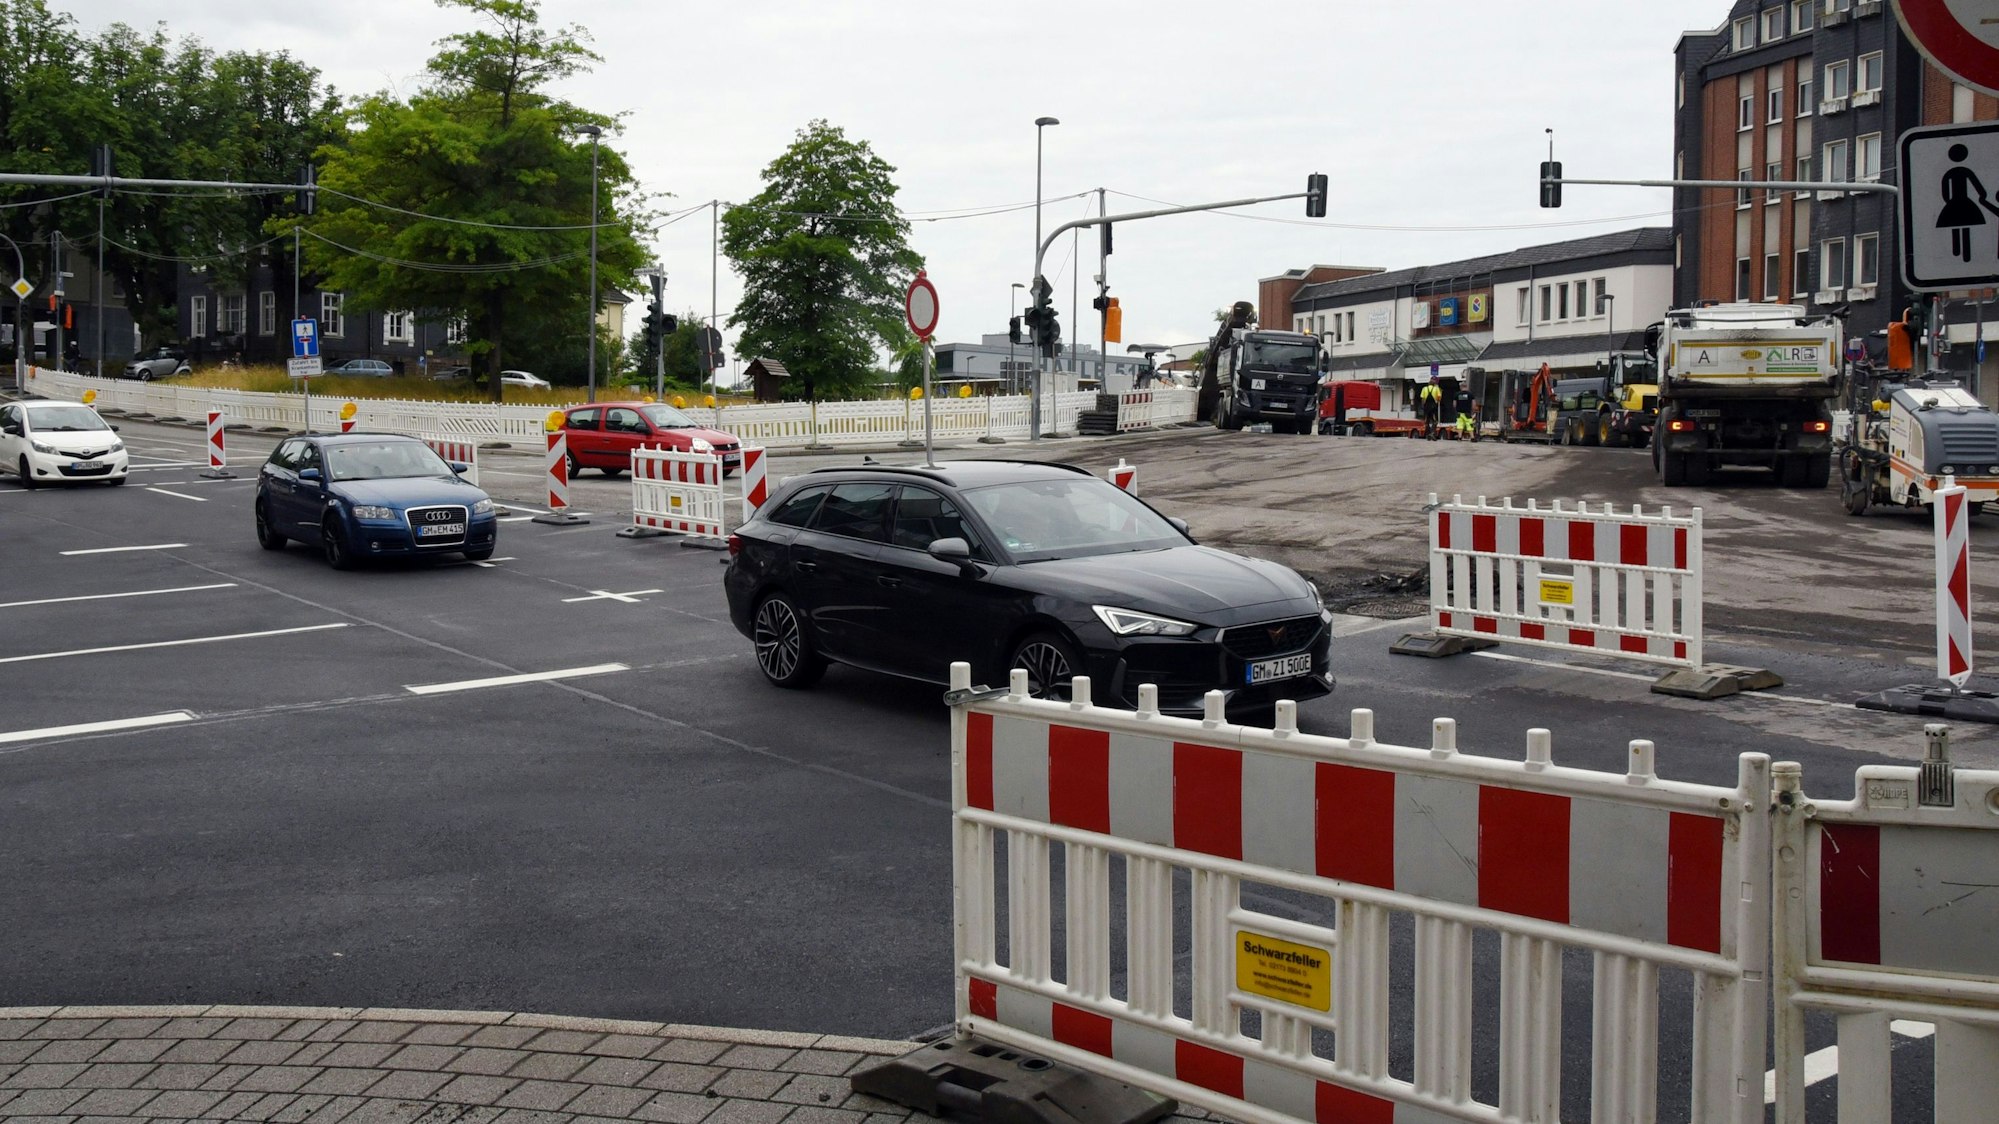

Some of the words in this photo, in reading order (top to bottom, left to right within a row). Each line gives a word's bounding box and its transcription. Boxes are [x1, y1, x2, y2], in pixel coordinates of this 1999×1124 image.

[1697, 349, 1711, 364] A
[1255, 380, 1262, 388] A
[422, 526, 433, 535] GM
[449, 523, 463, 533] 415
[1252, 663, 1266, 680] GM
[1273, 660, 1285, 677] ZI
[1287, 655, 1311, 674] 500E
[1243, 940, 1322, 969] Schwarzfeller
